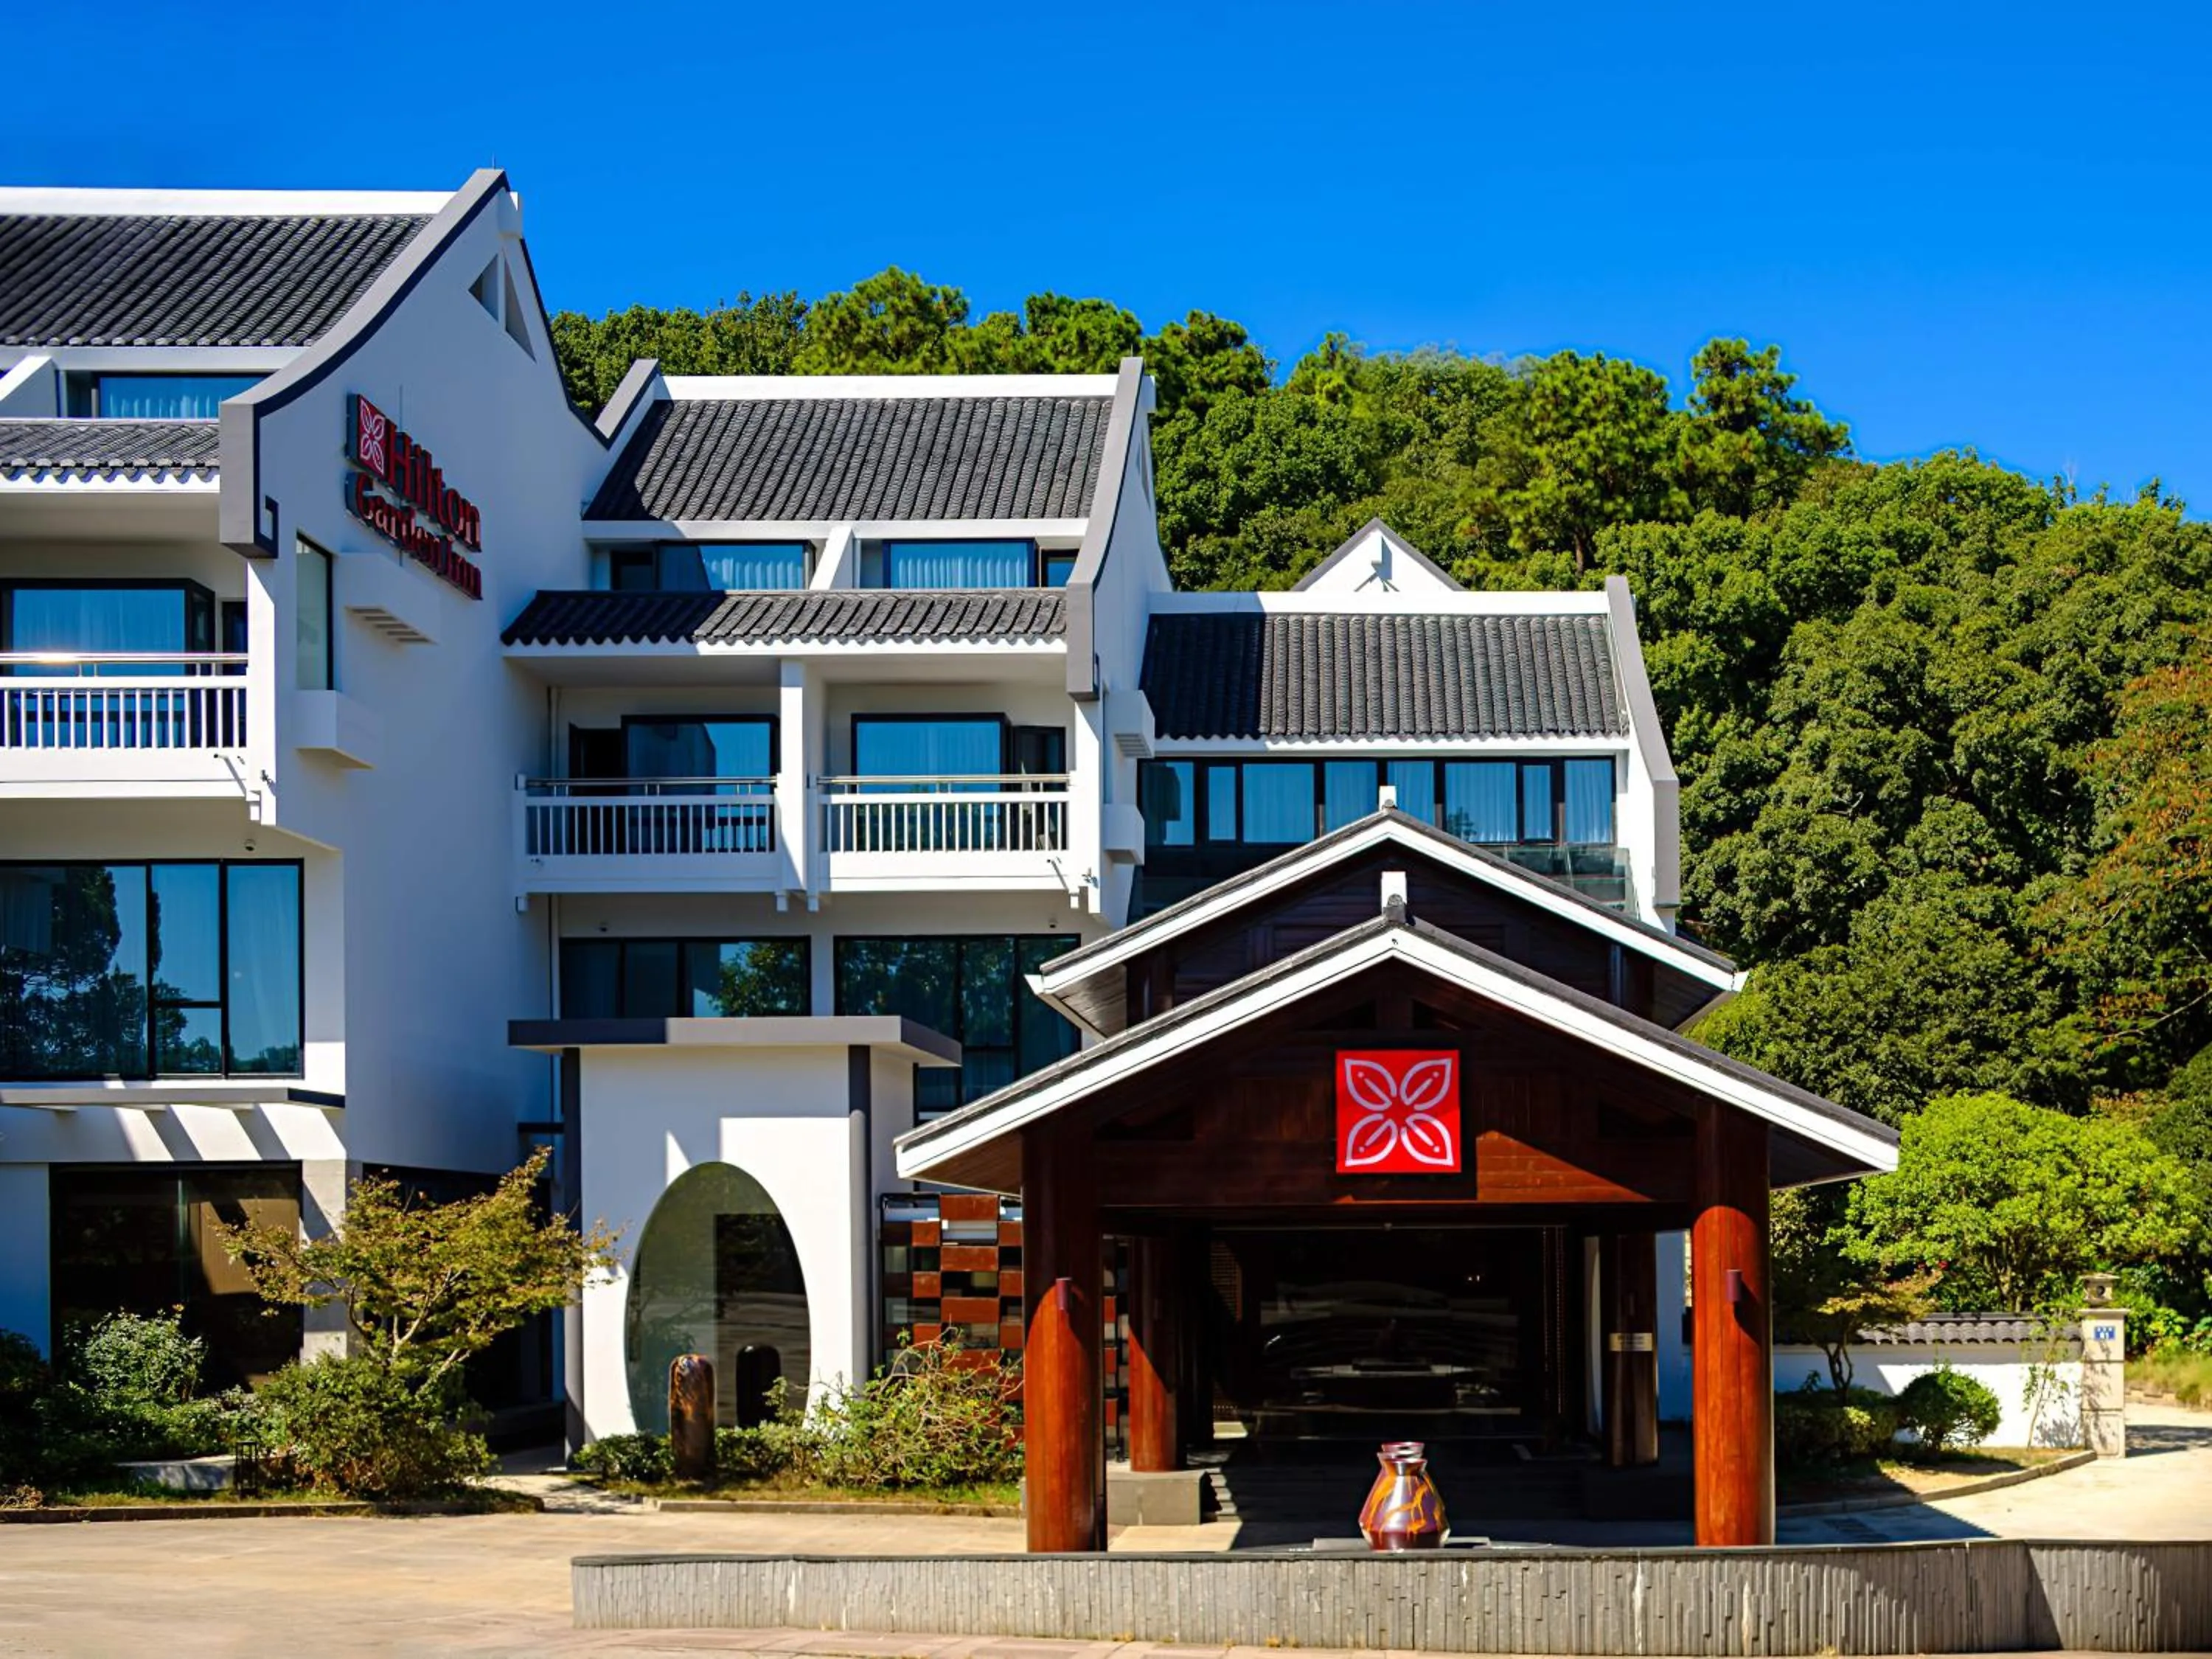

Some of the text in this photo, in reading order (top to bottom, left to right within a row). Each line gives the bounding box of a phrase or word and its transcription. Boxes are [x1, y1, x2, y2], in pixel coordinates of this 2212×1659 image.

[350, 472, 481, 599] Garden Inn
[387, 419, 481, 550] Hilton
